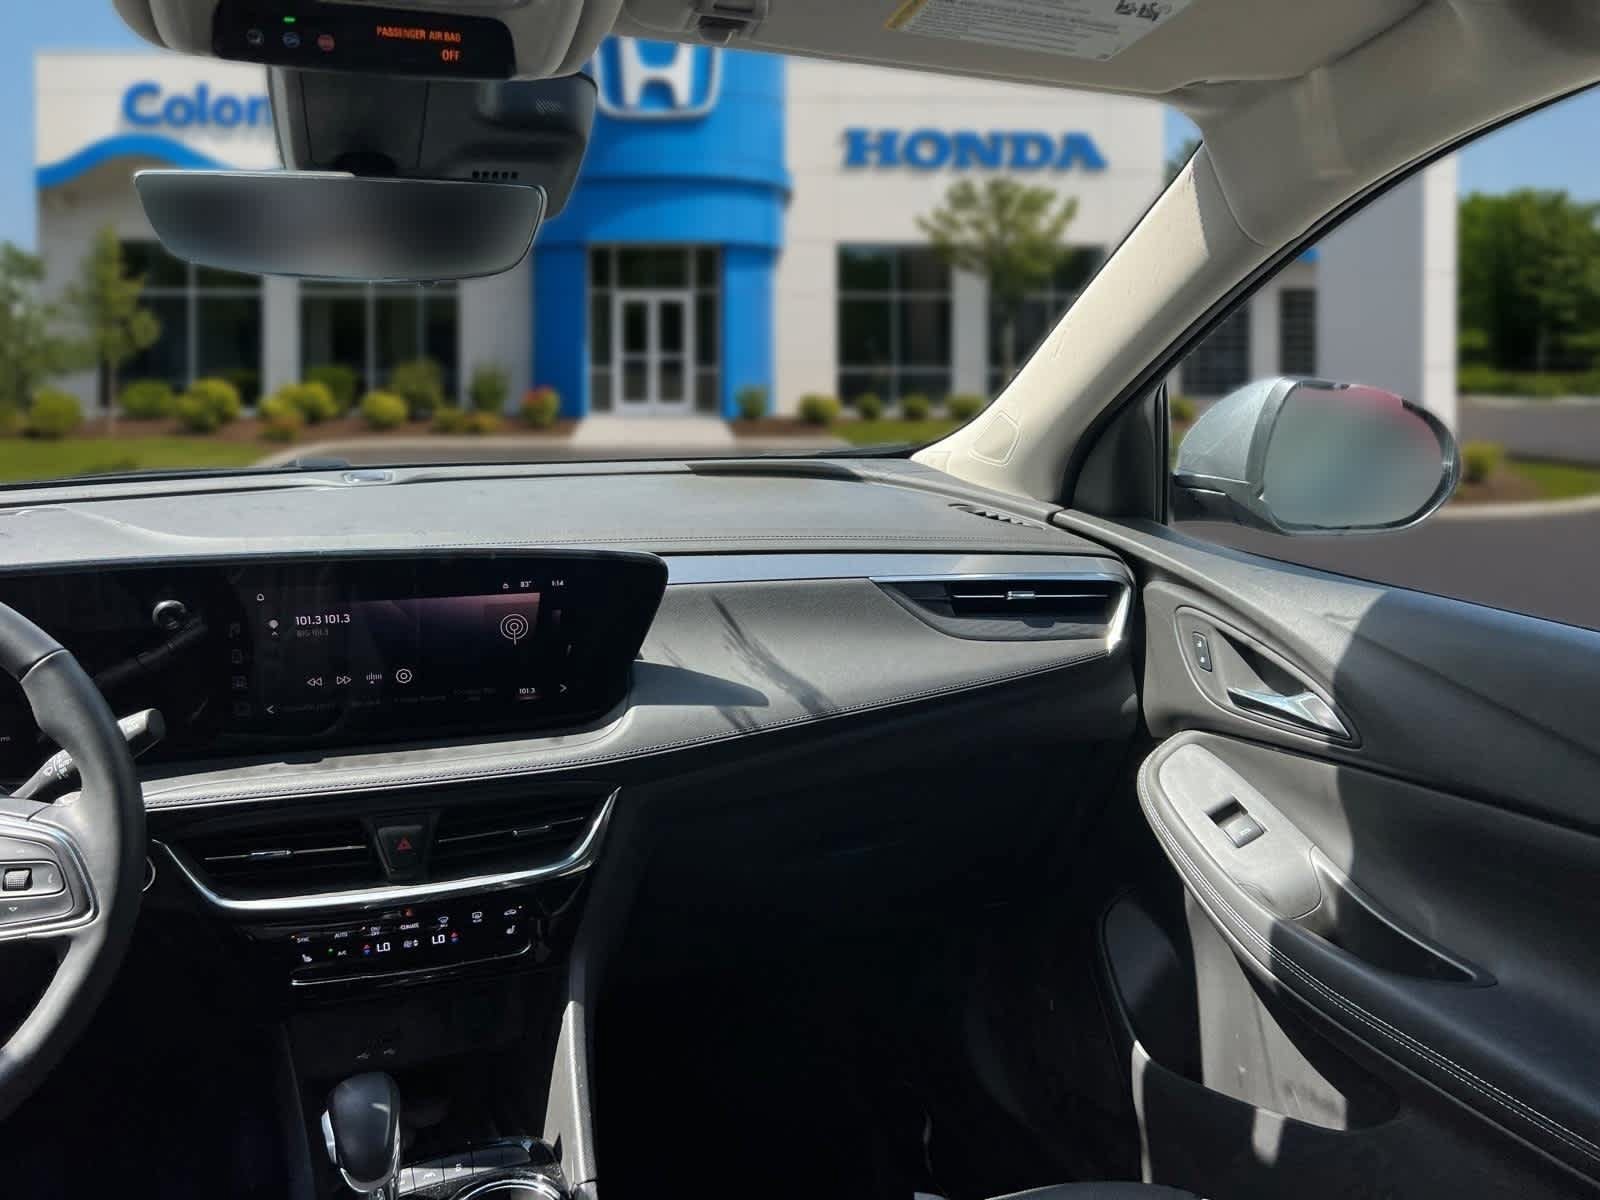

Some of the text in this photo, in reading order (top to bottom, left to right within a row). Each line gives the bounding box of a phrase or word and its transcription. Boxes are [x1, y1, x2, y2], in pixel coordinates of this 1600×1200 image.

[376, 25, 426, 40] PASSENGER
[441, 49, 461, 61] OFF
[841, 127, 1108, 172] HONDA
[295, 613, 351, 626] 101.3 101.3
[432, 934, 446, 945] LO
[377, 942, 391, 953] LO
